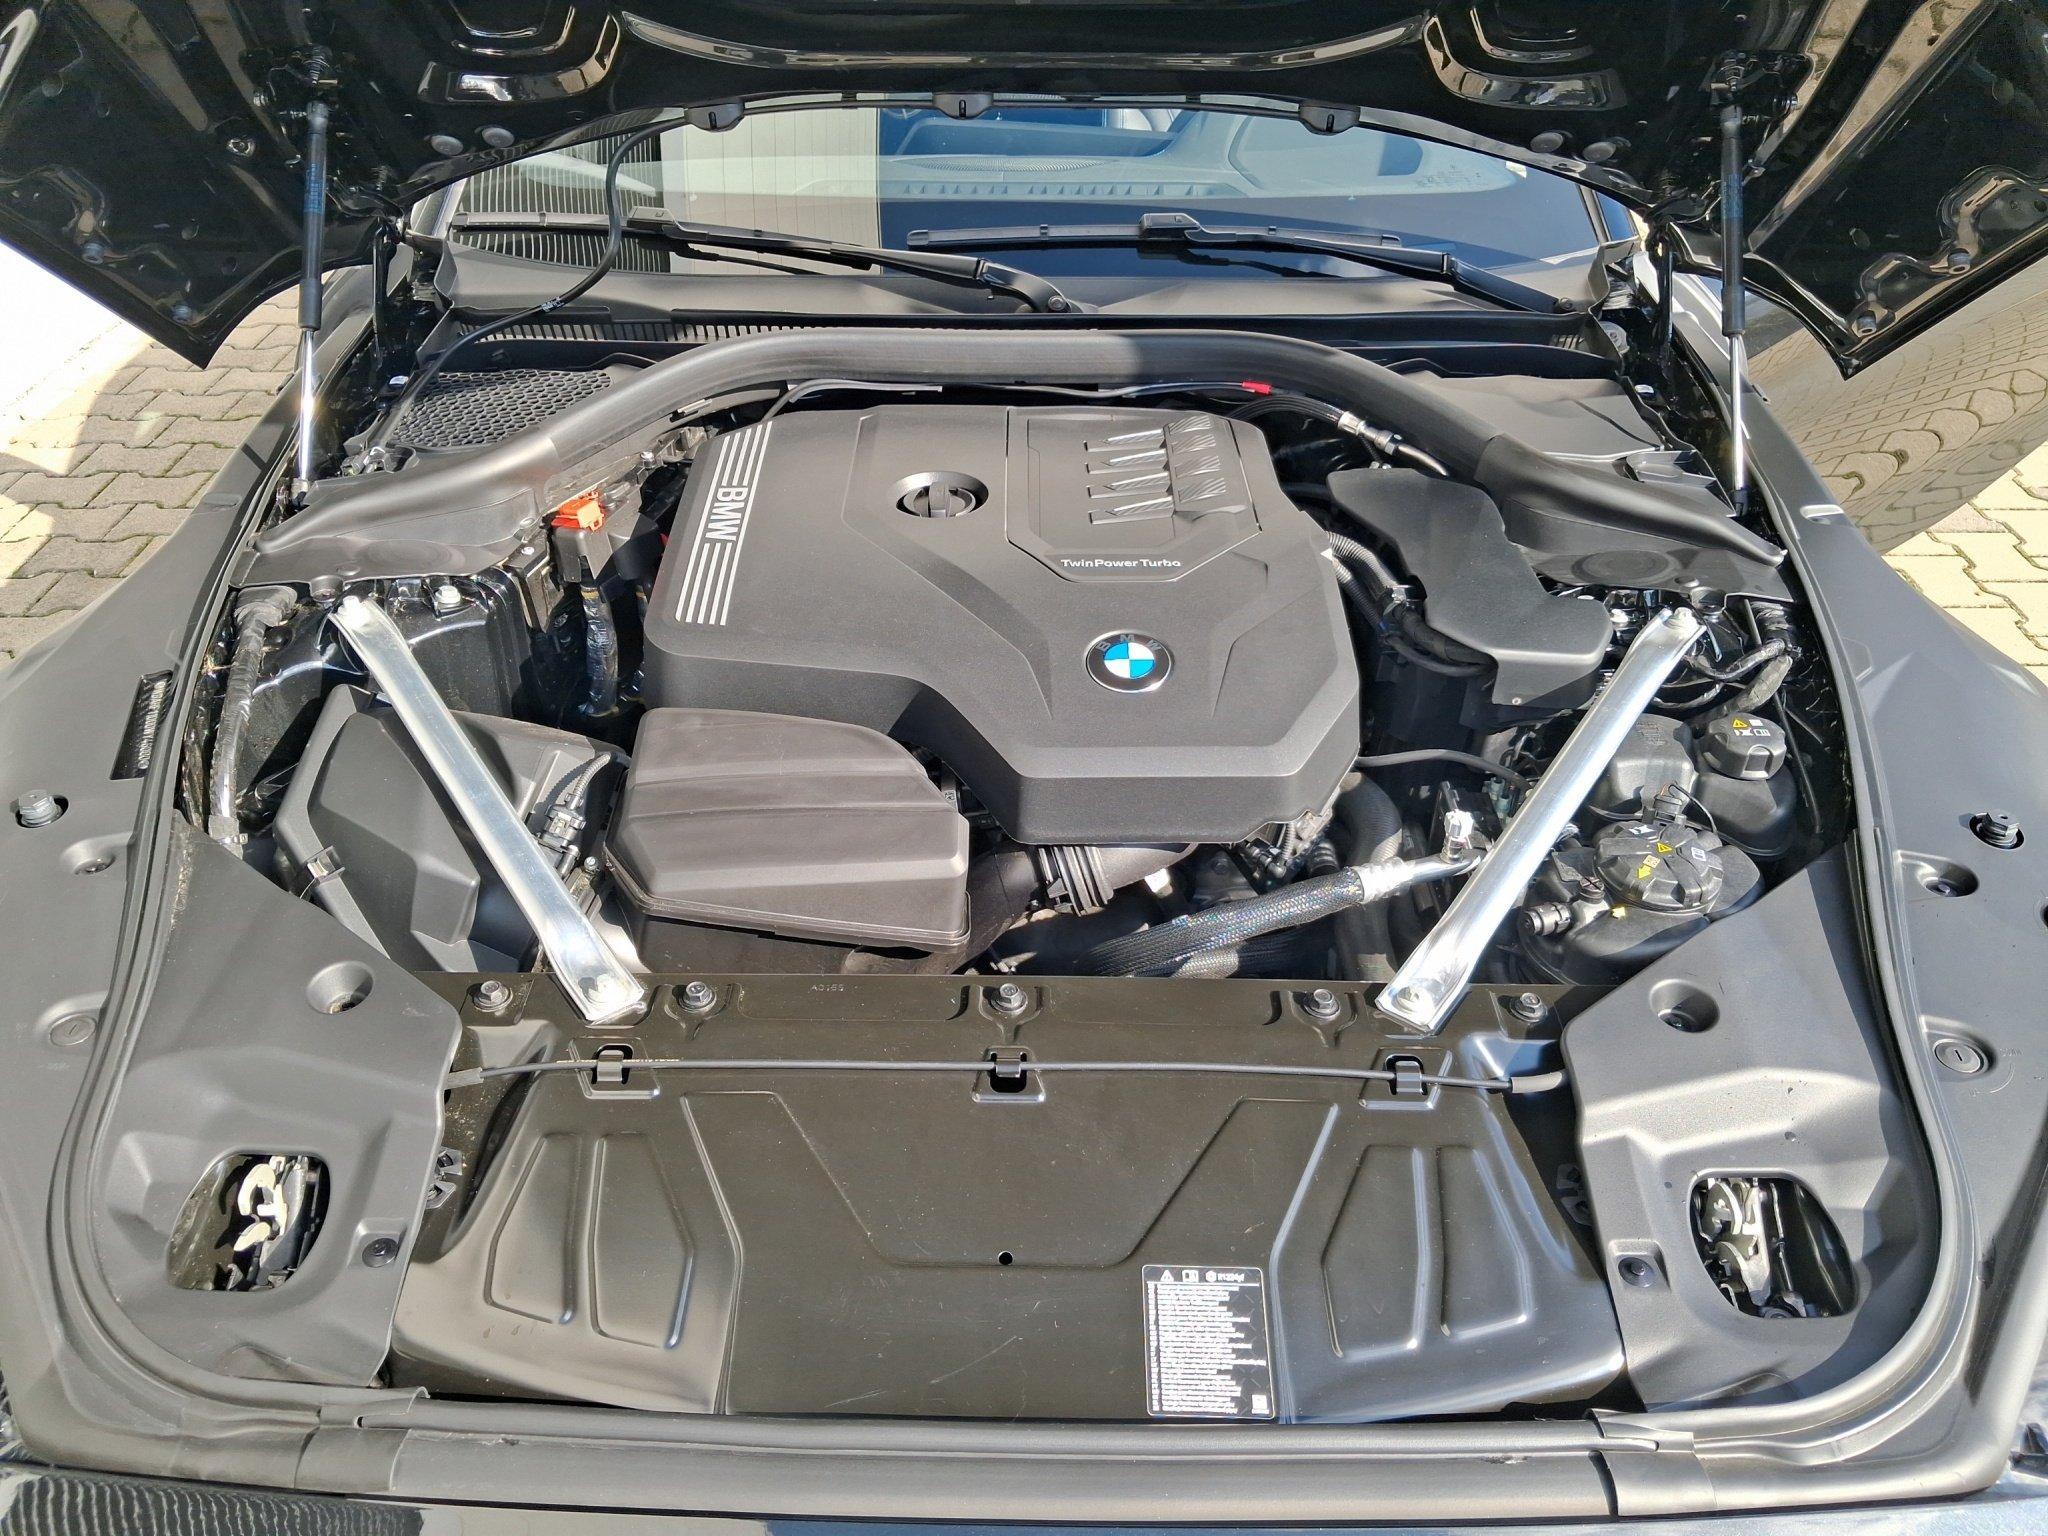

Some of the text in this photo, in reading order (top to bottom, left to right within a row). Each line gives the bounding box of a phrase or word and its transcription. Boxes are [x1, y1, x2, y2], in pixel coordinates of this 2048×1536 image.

[705, 487, 748, 541] BMW
[1060, 559, 1181, 567] TwinPower Turbo
[1095, 634, 1161, 652] BMW
